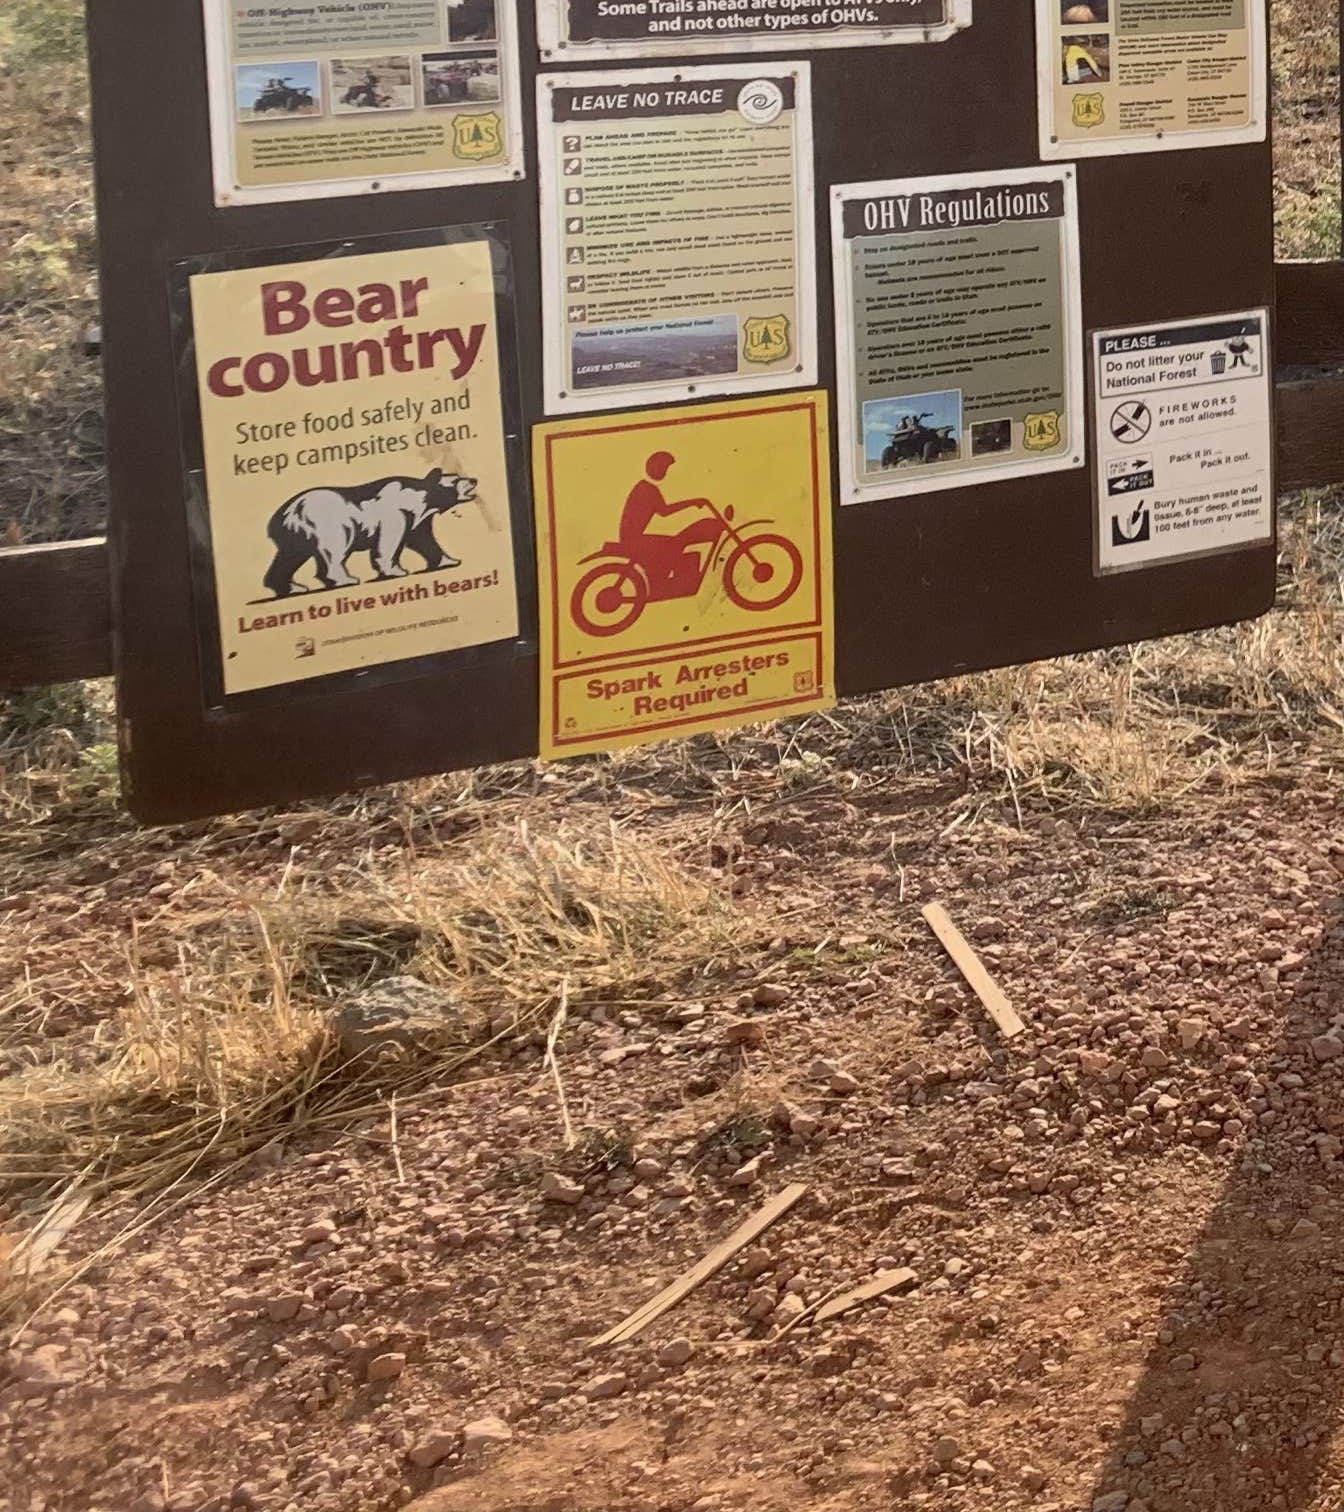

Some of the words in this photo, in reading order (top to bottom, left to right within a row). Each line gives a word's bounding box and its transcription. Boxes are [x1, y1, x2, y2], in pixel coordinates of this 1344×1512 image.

[598, 0, 646, 16] Some
[648, 16, 681, 33] and
[685, 15, 713, 31] not
[716, 12, 760, 29] other
[764, 11, 808, 29] types
[811, 9, 828, 25] of
[831, 7, 879, 24] OHVs.
[571, 92, 629, 111] LEAVE
[633, 91, 660, 108] NO
[664, 89, 723, 106] TRACE
[864, 198, 911, 231] OHV
[920, 189, 1050, 228] Regulations
[260, 276, 429, 336] Bear
[207, 323, 487, 398] country
[1106, 360, 1123, 373] Do
[1126, 357, 1145, 370] not
[1148, 354, 1174, 367] litter
[1178, 351, 1204, 366] your
[1106, 372, 1155, 389] National
[1159, 367, 1197, 383] Forest
[235, 421, 297, 445] Store
[302, 406, 354, 436] food
[361, 398, 425, 427] safely
[431, 390, 471, 416] and
[1159, 395, 1237, 416] FIREWORKS
[1159, 416, 1175, 428] are
[1178, 414, 1194, 425] not
[1198, 407, 1236, 421] allowed.
[233, 452, 288, 476] keep
[296, 433, 409, 465] campsites
[414, 423, 478, 451] clean.
[1169, 453, 1192, 464] Pack
[1195, 450, 1201, 460] it
[1203, 448, 1212, 458] in
[1200, 458, 1223, 470] Pack
[1225, 454, 1231, 464] it
[238, 609, 303, 634] Learn
[308, 603, 332, 620] to
[336, 595, 376, 616] live
[381, 585, 428, 608] with
[433, 568, 499, 597] bears!
[586, 671, 662, 701] Spark
[675, 650, 790, 686] Arresters
[633, 678, 748, 716] Required
